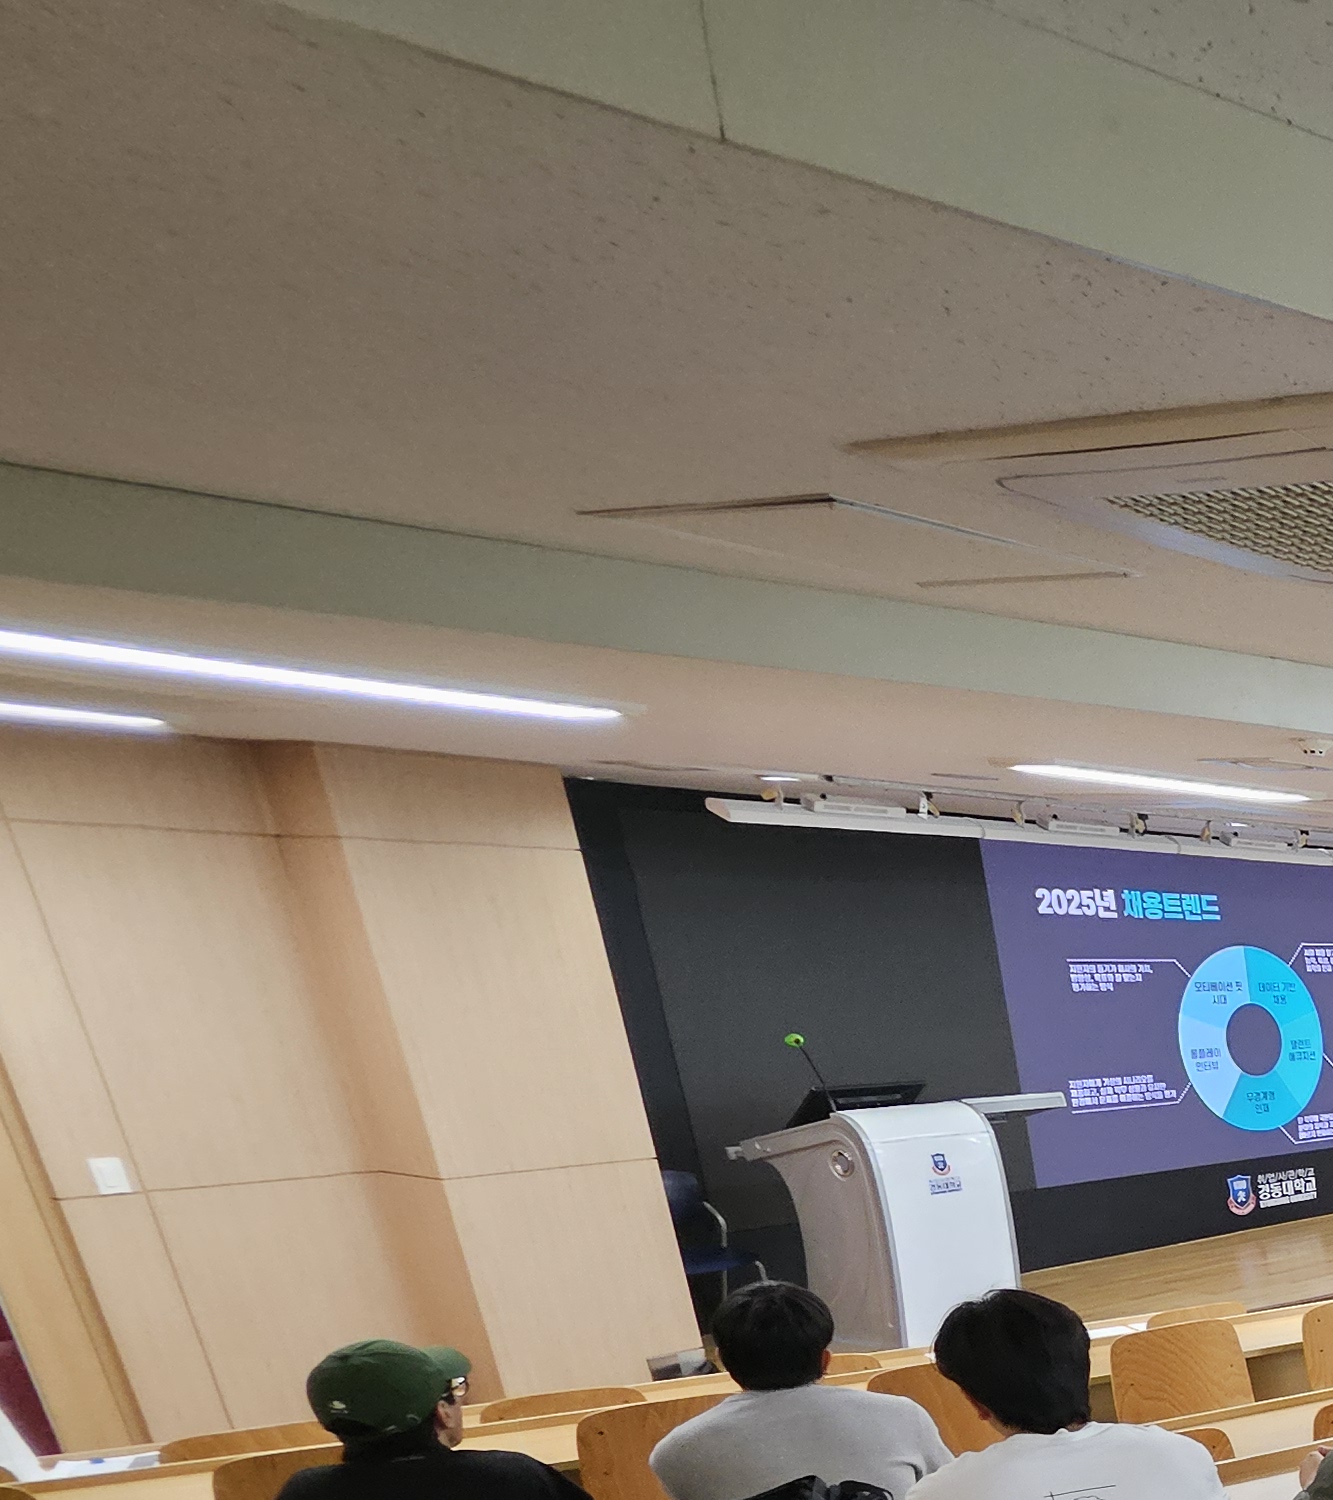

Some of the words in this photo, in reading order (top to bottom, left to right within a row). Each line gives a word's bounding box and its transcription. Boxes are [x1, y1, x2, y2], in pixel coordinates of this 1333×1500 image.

[1035, 887, 1118, 919] 2025년
[1121, 889, 1221, 921] 채용트렌드
[1258, 982, 1280, 993] 데이터
[1281, 982, 1296, 993] 기반
[1258, 1177, 1317, 1200] 경동대학교
